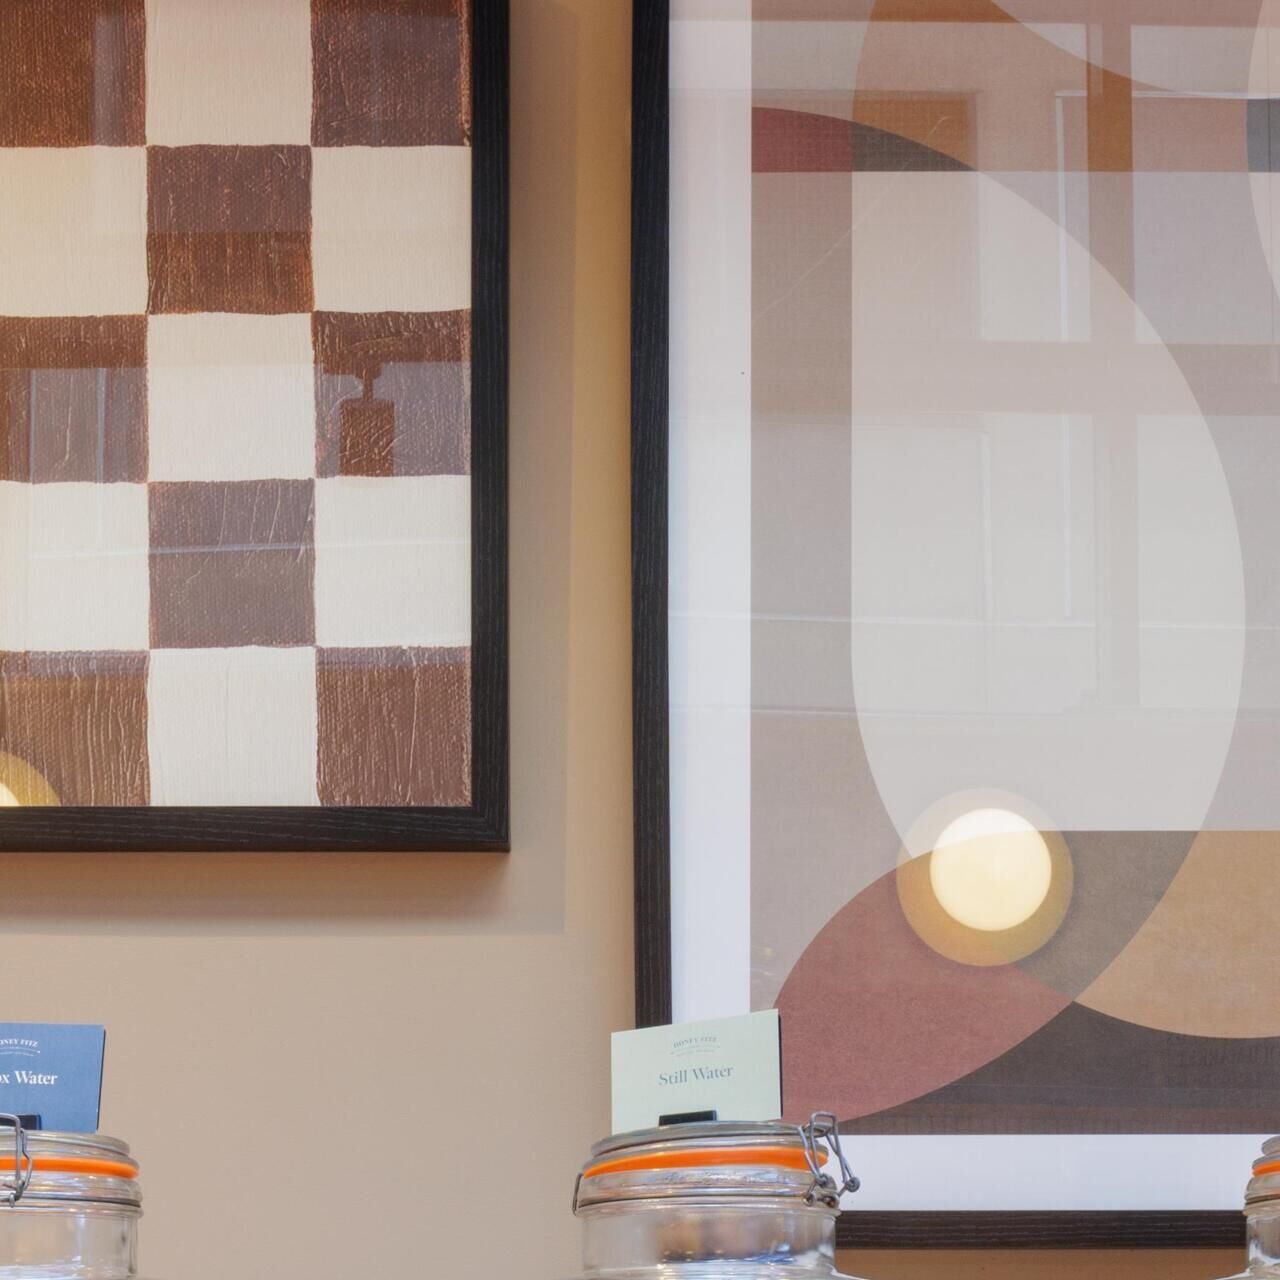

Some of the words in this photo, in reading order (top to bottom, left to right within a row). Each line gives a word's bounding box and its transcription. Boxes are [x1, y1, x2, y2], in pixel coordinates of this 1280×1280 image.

[20, 1038, 39, 1048] FITZ
[14, 1070, 58, 1085] Water
[658, 1069, 688, 1087] Still
[692, 1065, 734, 1082] Water
